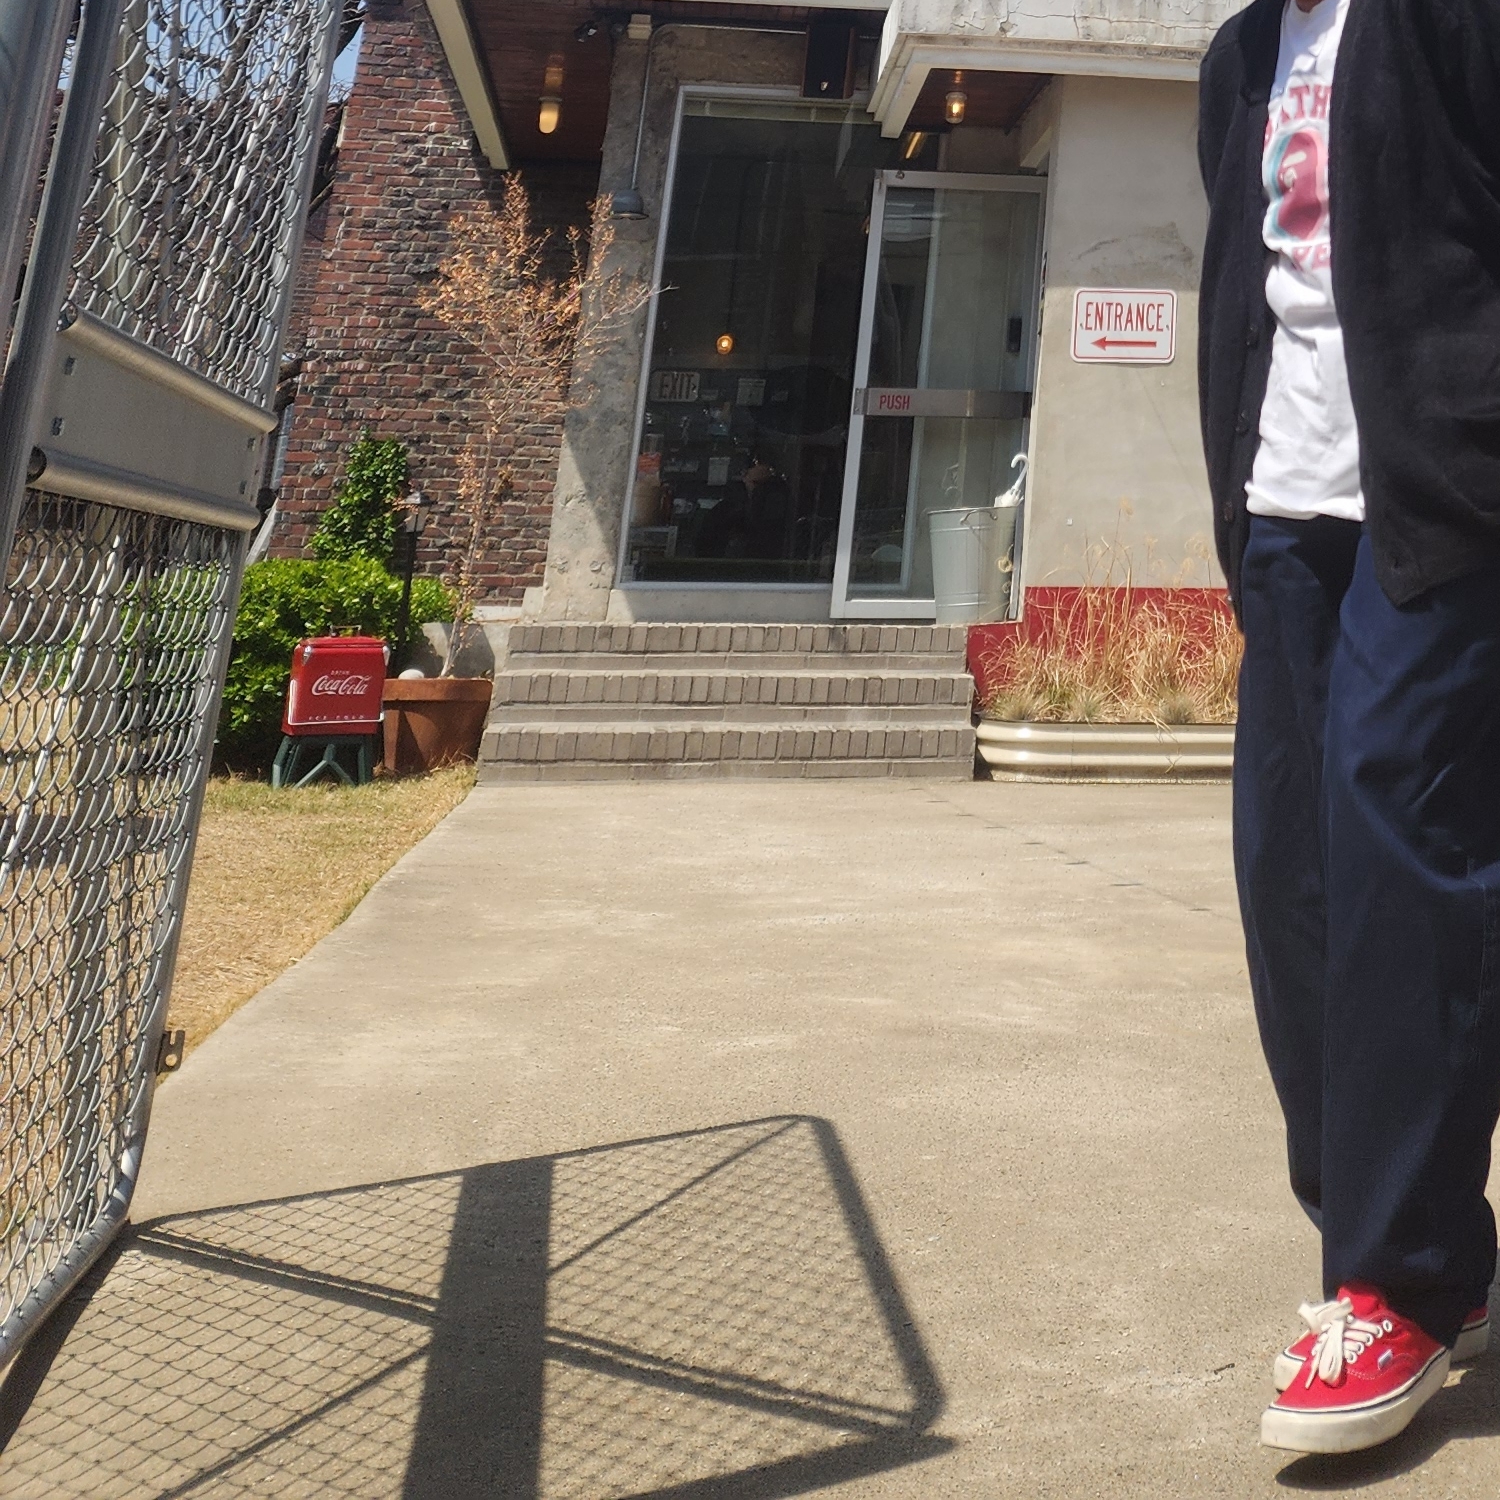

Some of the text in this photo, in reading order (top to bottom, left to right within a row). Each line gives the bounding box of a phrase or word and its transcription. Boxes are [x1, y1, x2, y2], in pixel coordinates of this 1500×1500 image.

[1085, 301, 1164, 332] ENTRANCE
[660, 372, 695, 399] EXIT
[879, 394, 910, 410] PUSH
